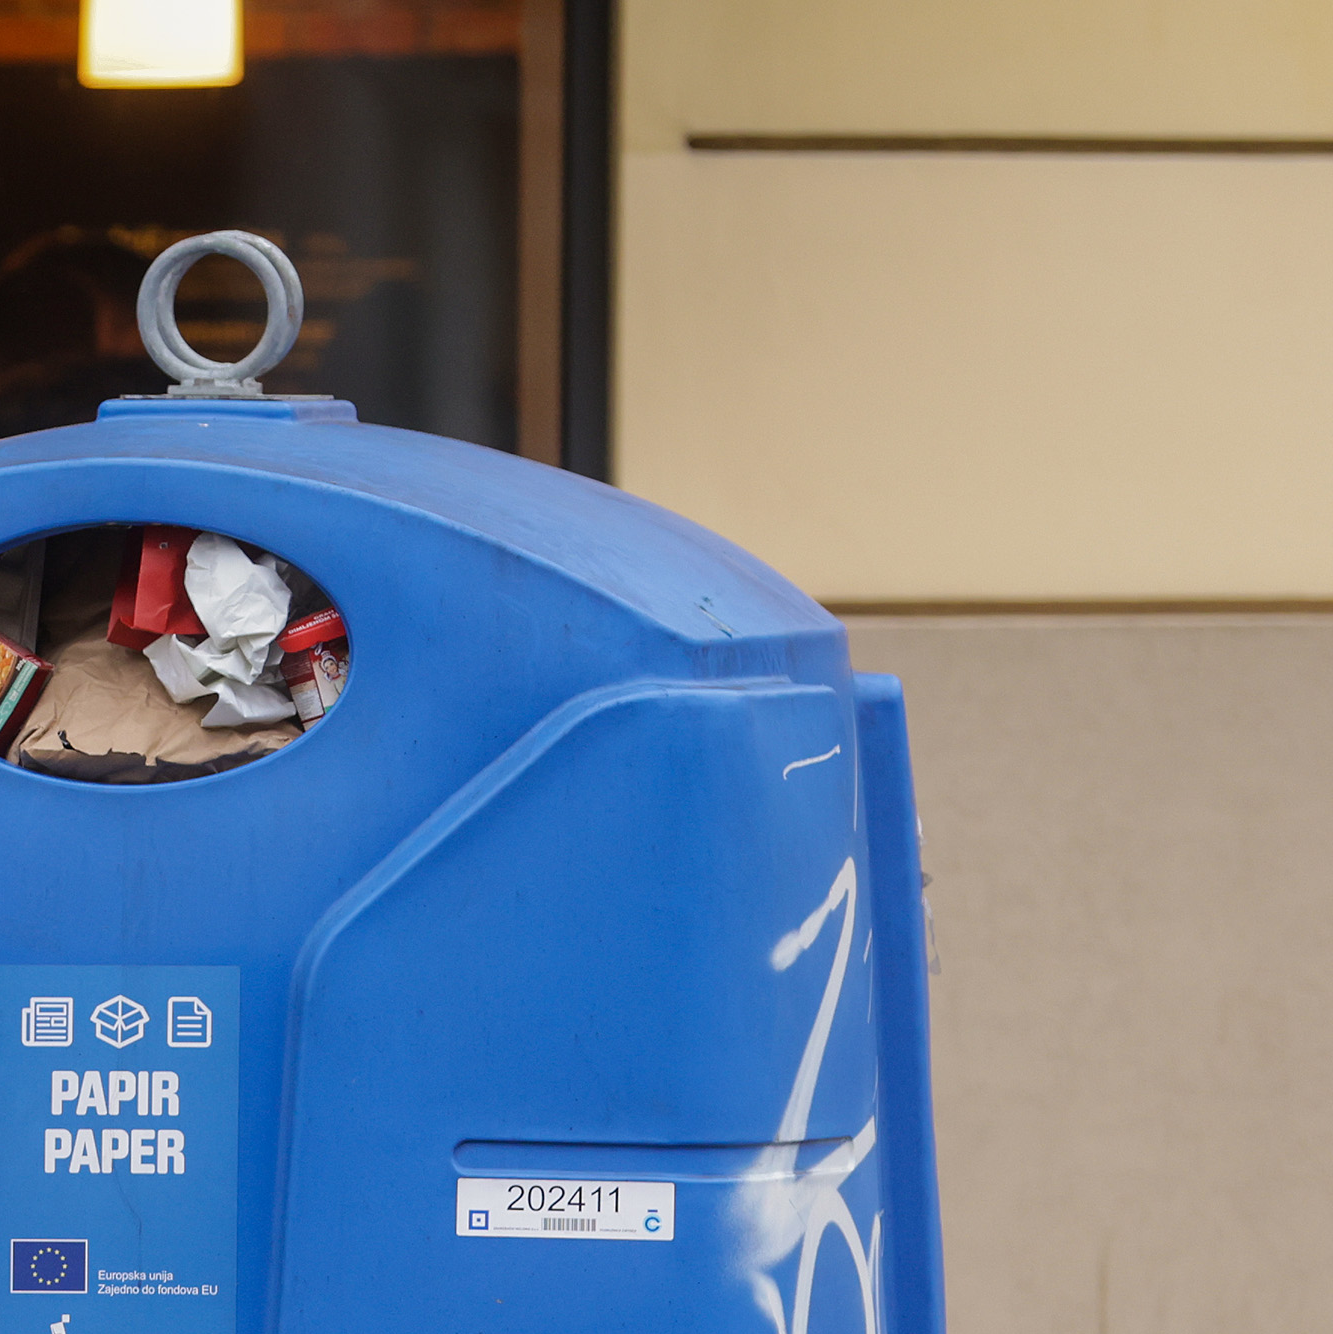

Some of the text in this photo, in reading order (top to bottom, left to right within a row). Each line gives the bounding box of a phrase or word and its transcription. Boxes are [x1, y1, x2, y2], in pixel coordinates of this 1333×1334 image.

[51, 1070, 180, 1116] PAPIR
[44, 1128, 185, 1175] PAPER
[506, 1184, 621, 1213] 202411
[98, 1269, 173, 1282] Europska unija
[98, 1284, 218, 1296] Zajedno do fondova EU
